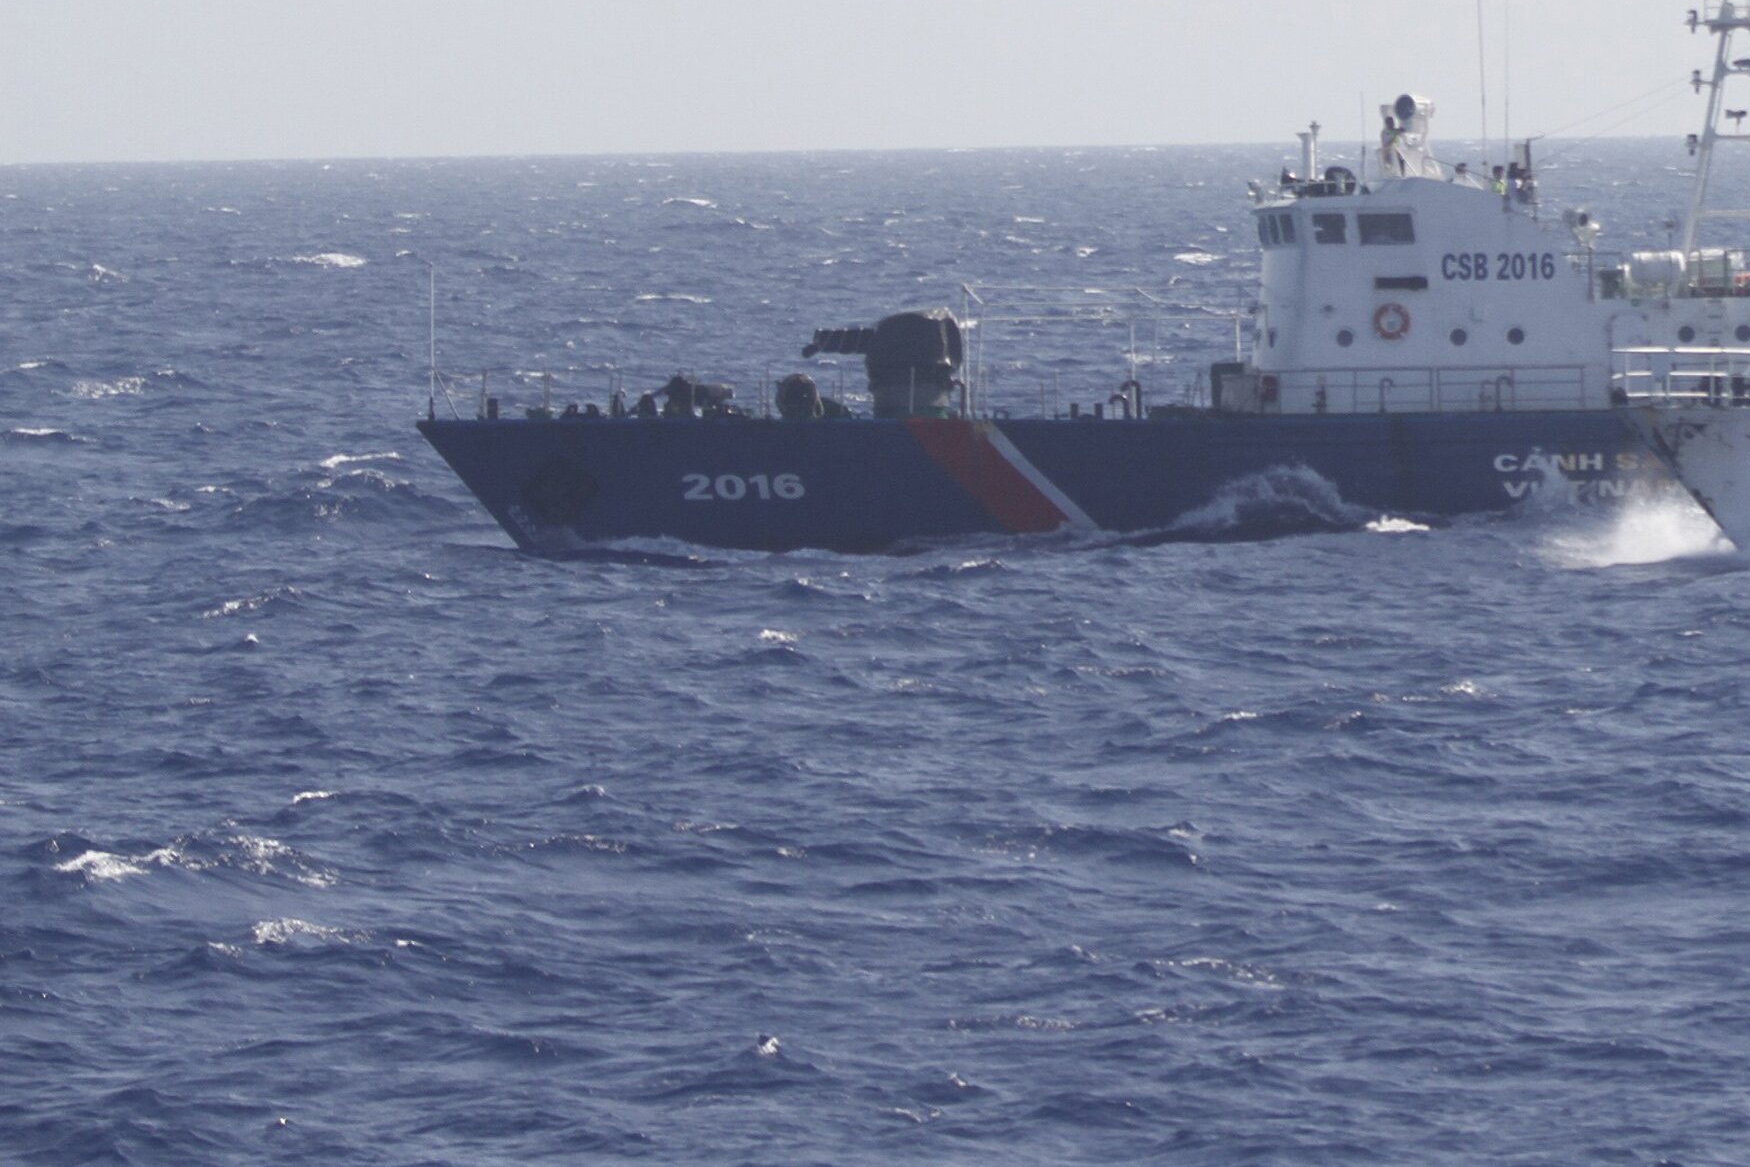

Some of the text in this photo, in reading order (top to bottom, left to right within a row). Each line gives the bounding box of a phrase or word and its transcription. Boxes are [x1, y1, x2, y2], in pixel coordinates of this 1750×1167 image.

[1442, 253, 1555, 280] CSB 2016
[681, 473, 806, 501] 2016
